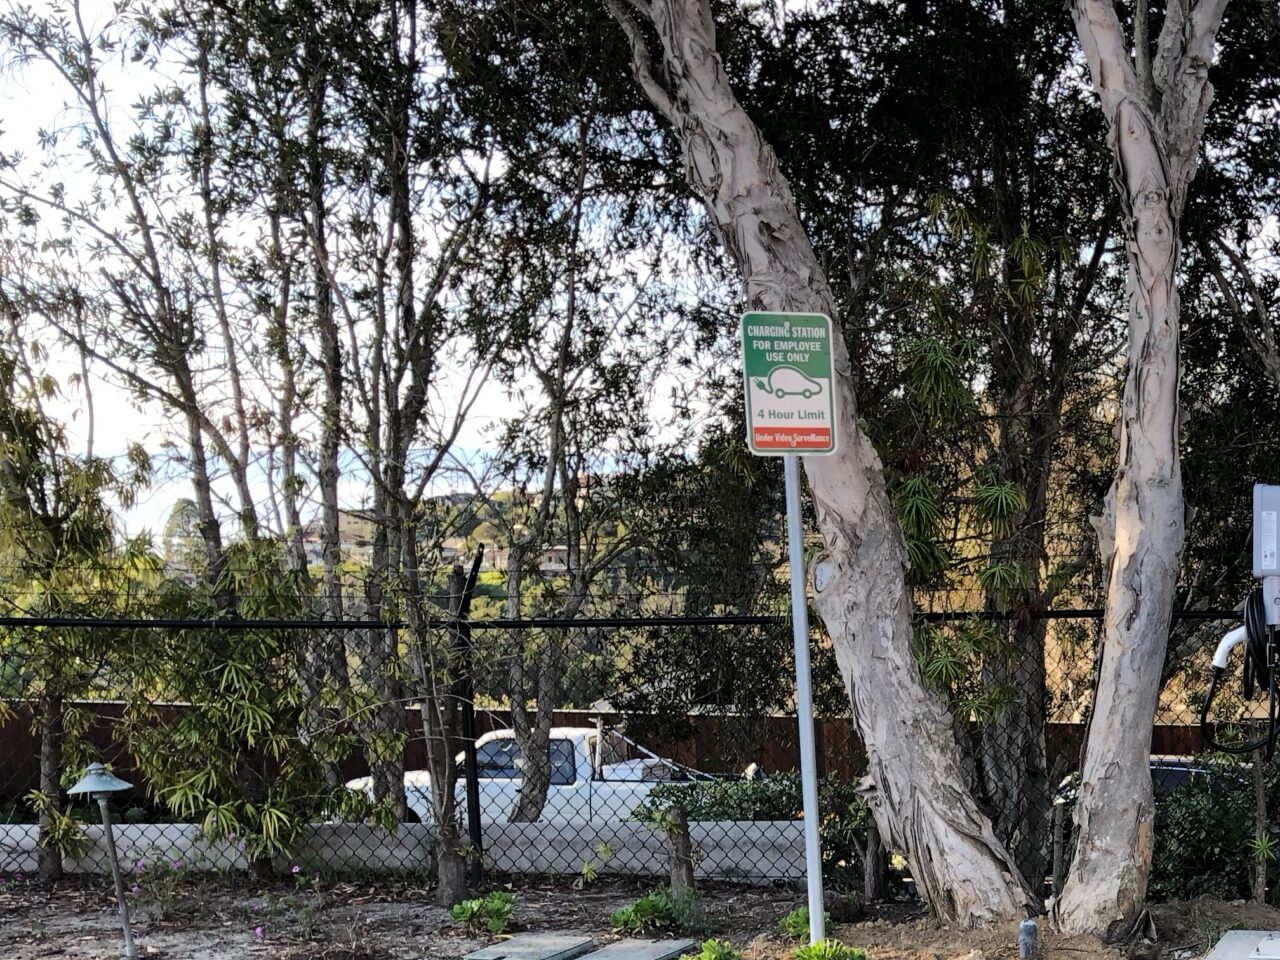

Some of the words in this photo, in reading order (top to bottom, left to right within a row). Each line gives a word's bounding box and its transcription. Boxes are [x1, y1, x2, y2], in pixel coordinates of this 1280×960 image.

[747, 325, 791, 337] CHARGING
[791, 326, 826, 339] STATION
[752, 340, 772, 350] FOR
[774, 341, 822, 351] EMPLOYEE
[765, 352, 785, 362] USE
[787, 352, 810, 362] ONLY
[757, 409, 765, 420] 4
[768, 409, 795, 420] Hour
[798, 409, 825, 420] Limit
[755, 433, 774, 442] Under
[775, 433, 792, 442] Video
